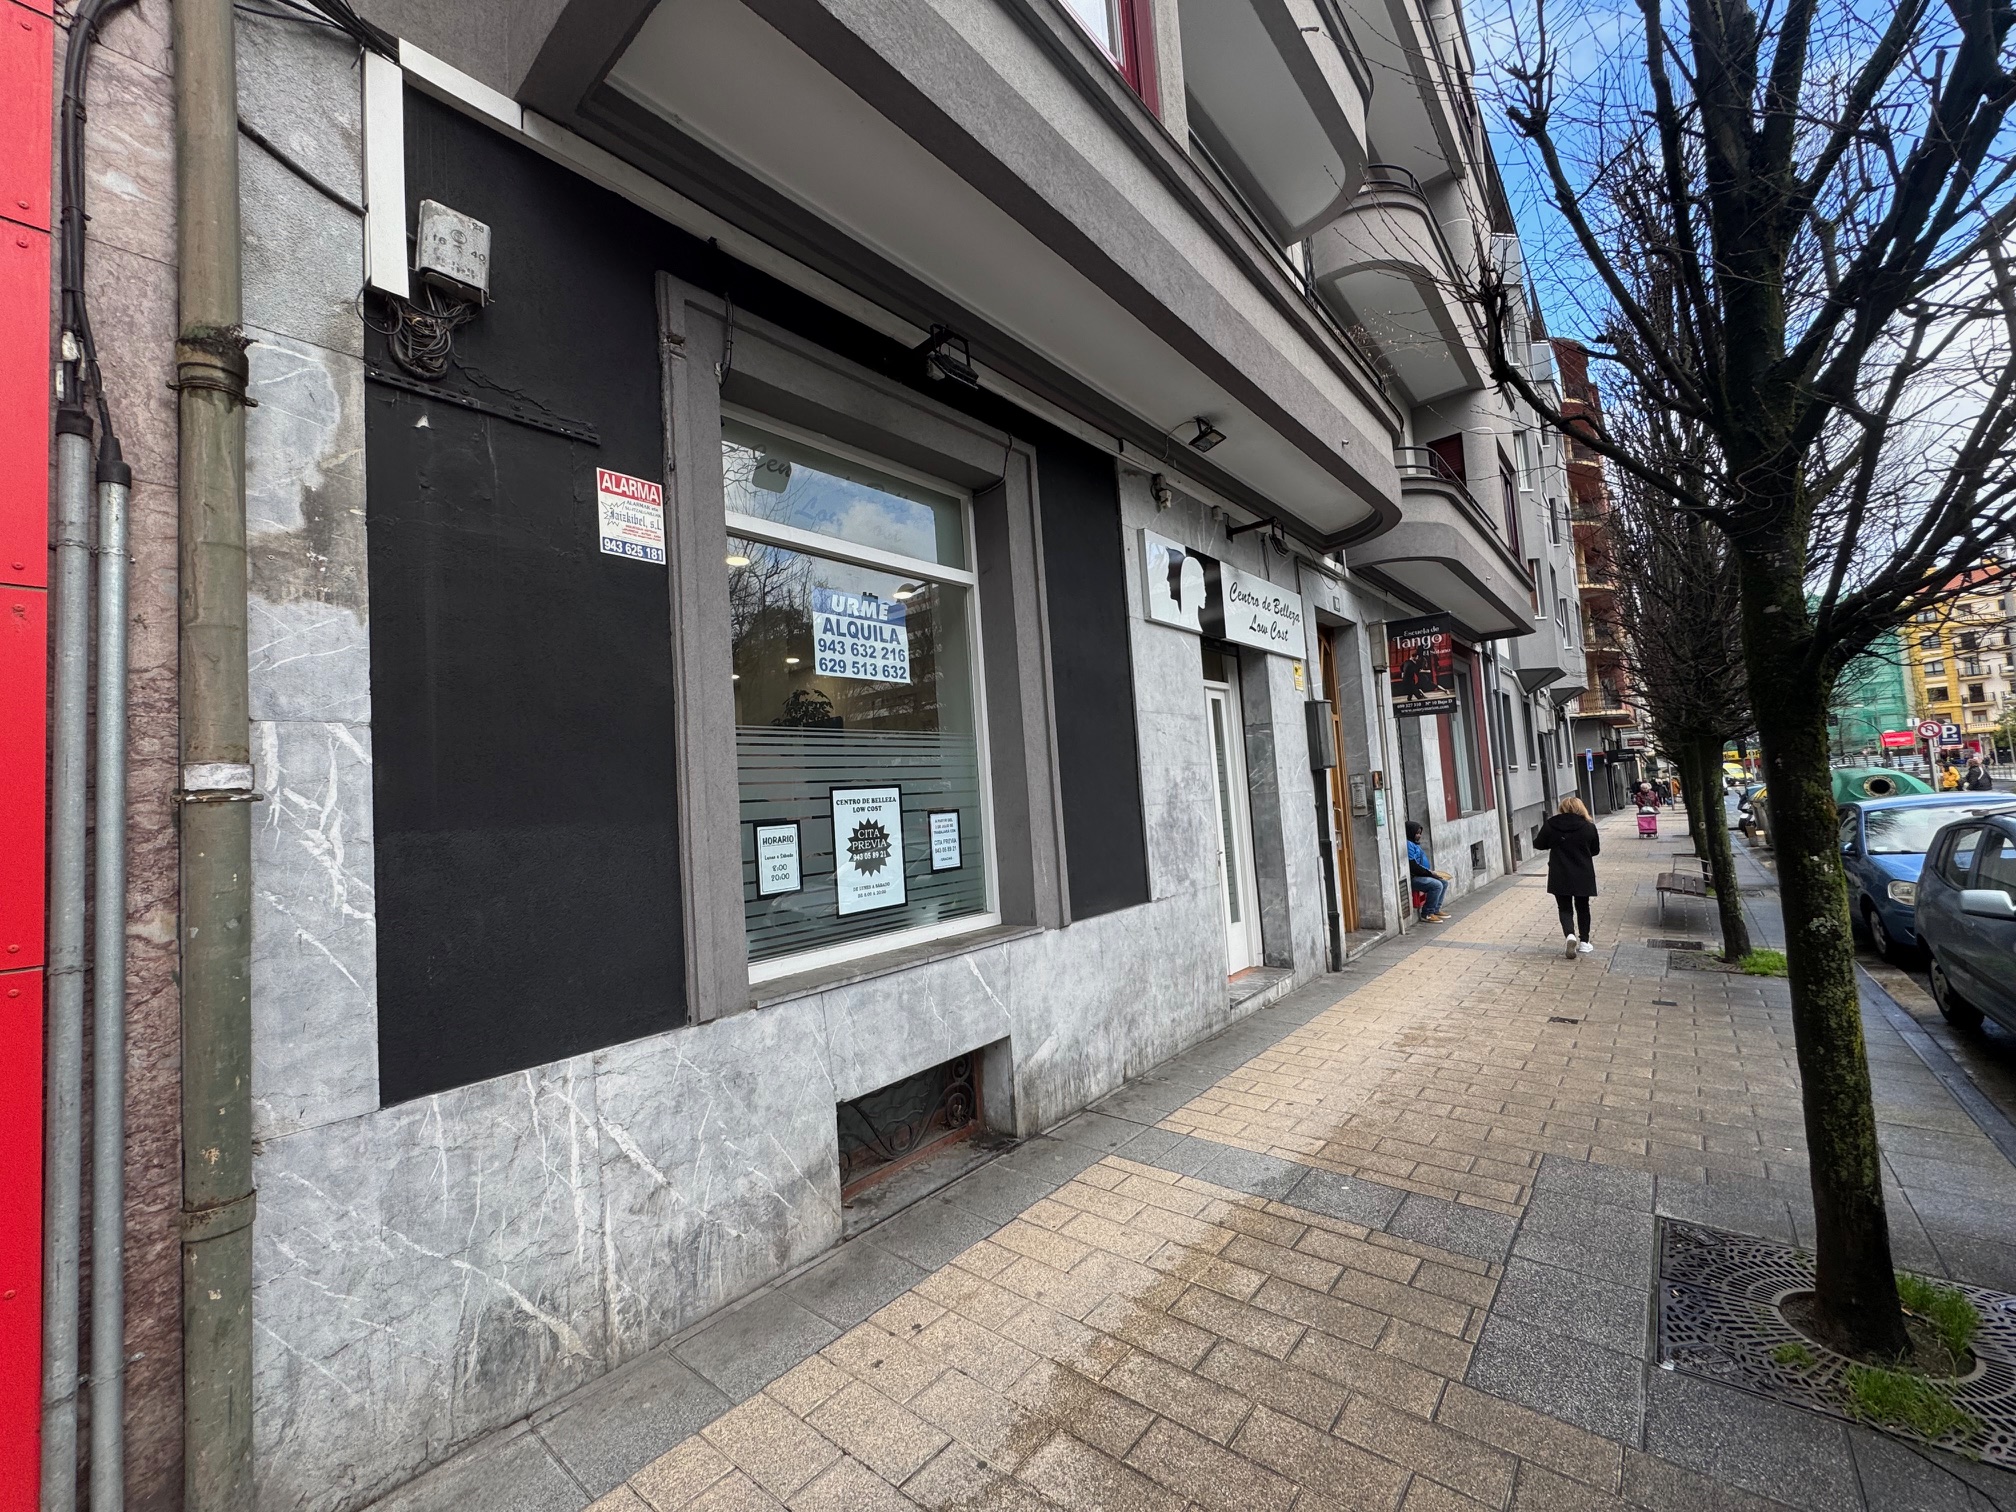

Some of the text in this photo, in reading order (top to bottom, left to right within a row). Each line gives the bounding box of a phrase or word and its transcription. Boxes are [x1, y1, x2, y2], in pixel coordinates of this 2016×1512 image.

[602, 473, 659, 503] ALARMA
[604, 538, 622, 553] 943
[625, 543, 643, 557] 625
[646, 546, 662, 560] 181
[831, 594, 890, 620] URME
[1229, 581, 1300, 626] Centro de Belleza
[822, 617, 901, 645] ALQUILA
[1249, 614, 1289, 642] Low Cost
[1430, 625, 1440, 633] de
[818, 638, 906, 662] 943 632 216
[1392, 633, 1443, 650] Tango
[819, 657, 907, 680] 629 513 632
[836, 798, 861, 806] CENTRO
[871, 796, 897, 804] BELLEZA
[762, 835, 794, 845] HORARIO
[857, 828, 880, 839] CITA
[852, 839, 887, 851] PREVIA
[852, 853, 863, 861] 943
[880, 850, 887, 858] 21
